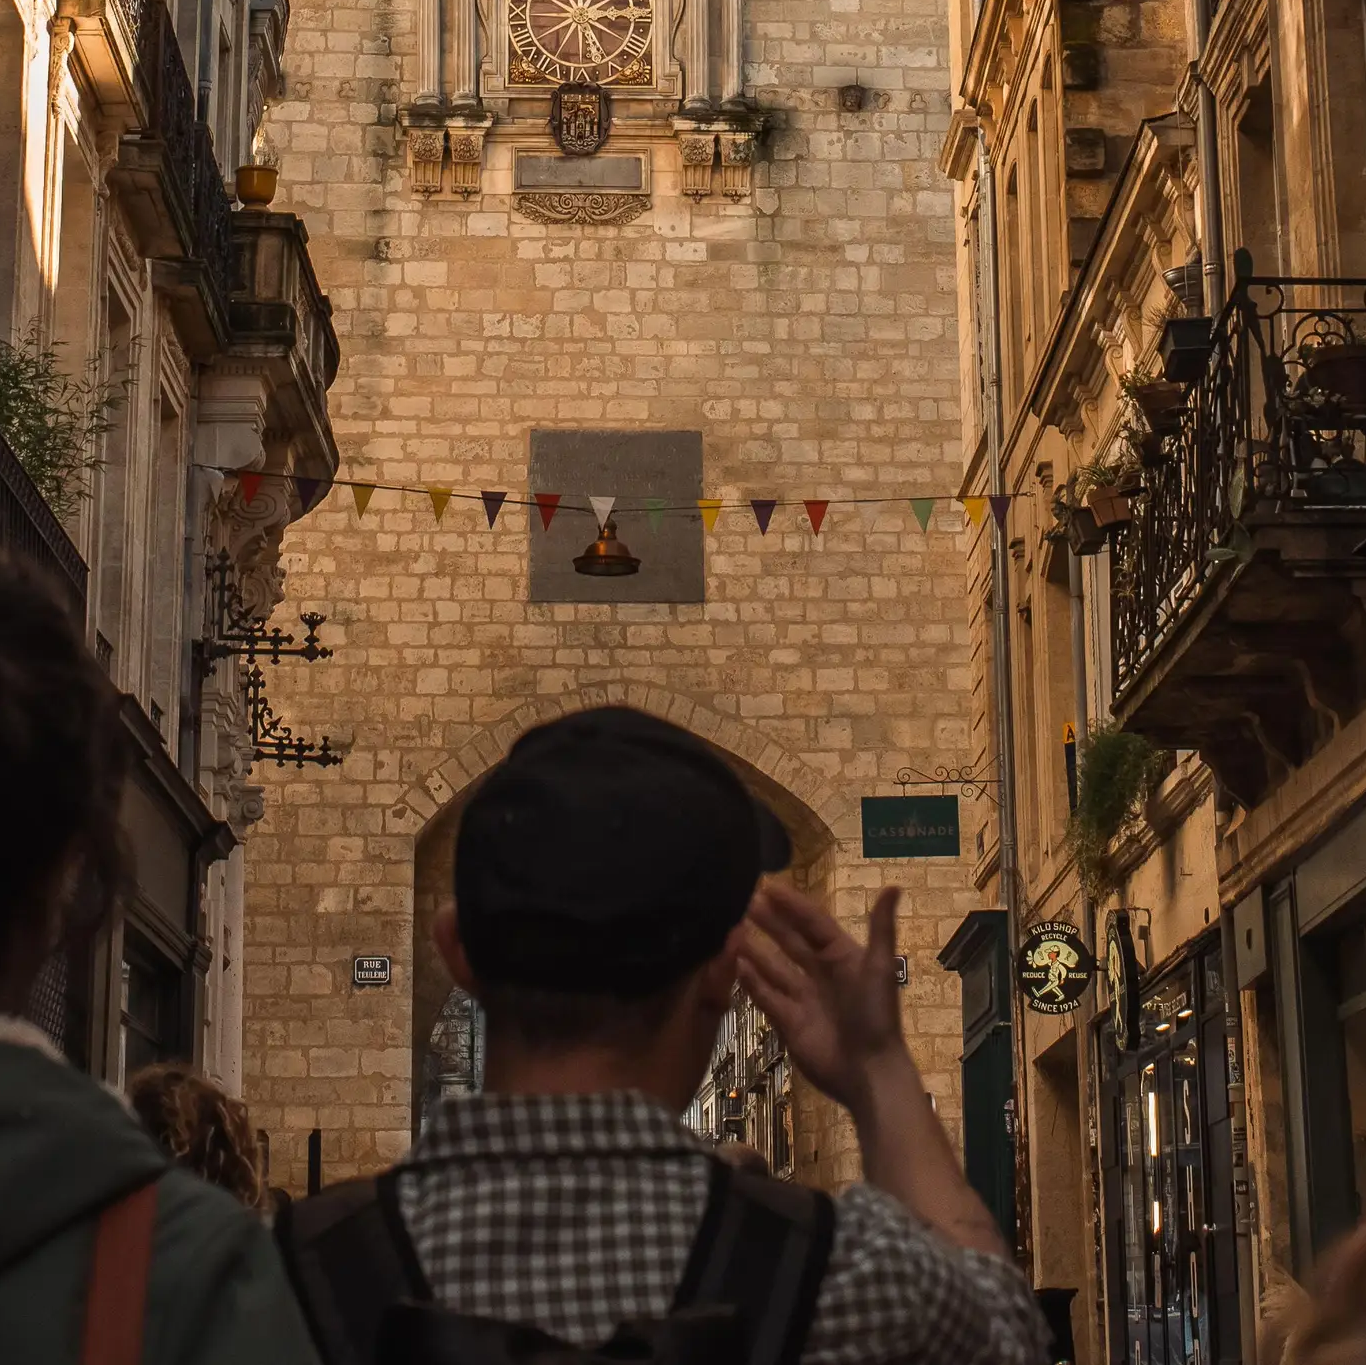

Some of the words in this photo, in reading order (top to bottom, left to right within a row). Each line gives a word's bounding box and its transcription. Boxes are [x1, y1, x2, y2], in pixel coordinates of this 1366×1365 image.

[1031, 923, 1051, 935] KILO
[1053, 922, 1078, 935] SHOP
[1041, 932, 1068, 941] RECYCLE
[363, 960, 381, 968] RUE
[1032, 999, 1058, 1012] SINCE
[1060, 999, 1079, 1012] 1974
